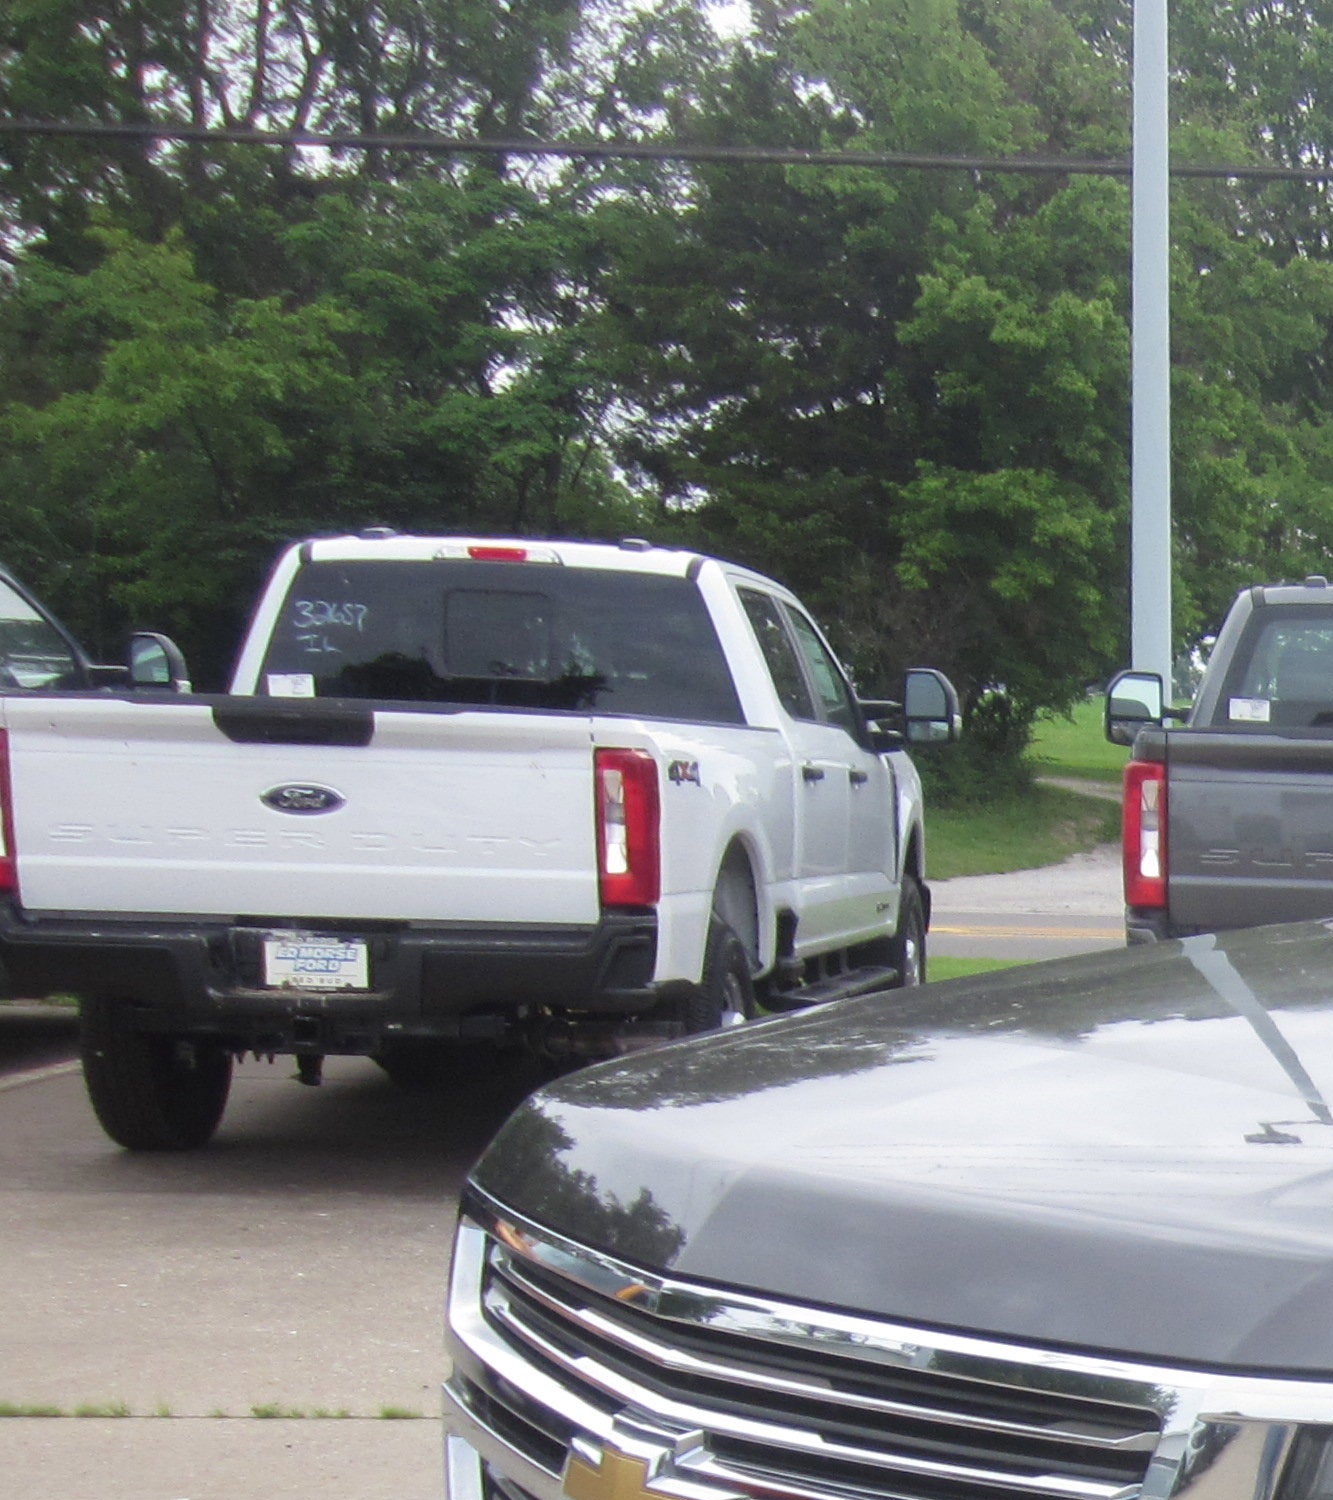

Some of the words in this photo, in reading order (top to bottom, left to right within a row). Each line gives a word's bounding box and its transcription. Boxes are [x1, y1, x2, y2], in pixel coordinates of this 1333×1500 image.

[49, 822, 327, 850] SUPER
[350, 830, 564, 856] DUTY
[293, 960, 342, 973] FORD
